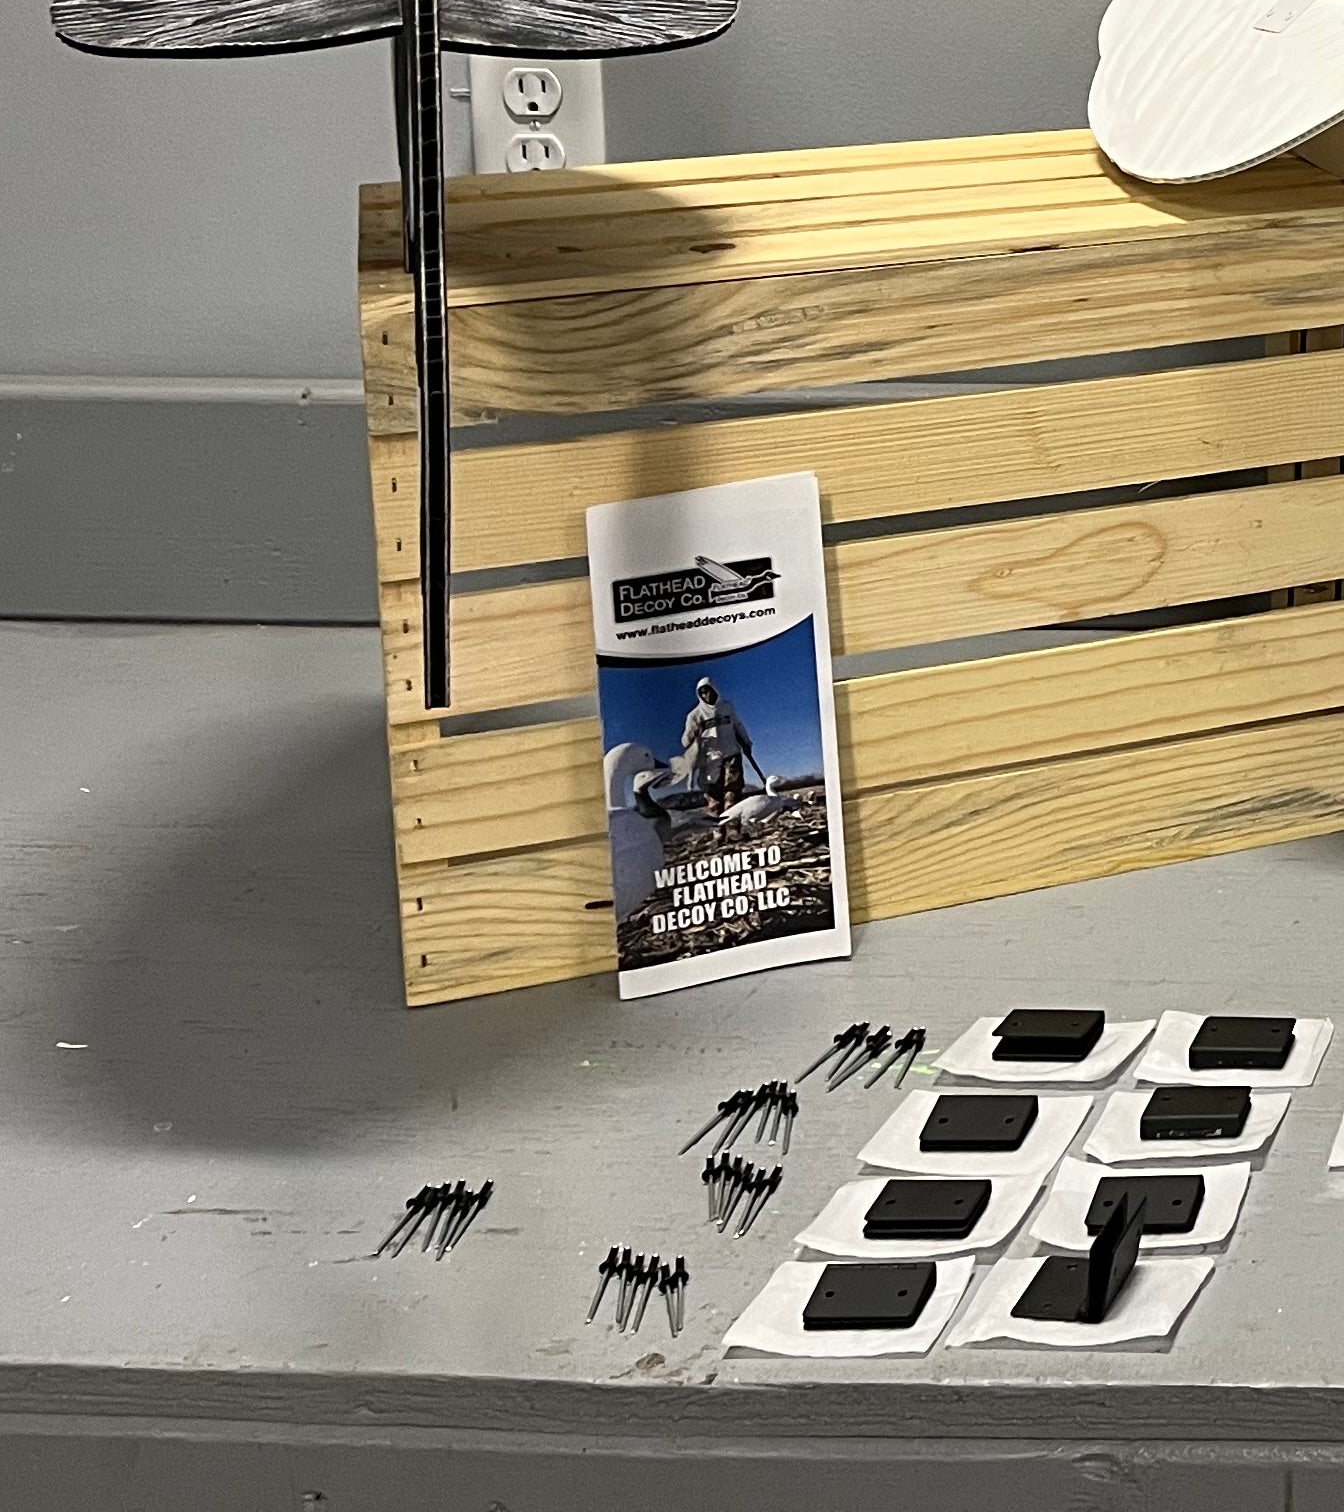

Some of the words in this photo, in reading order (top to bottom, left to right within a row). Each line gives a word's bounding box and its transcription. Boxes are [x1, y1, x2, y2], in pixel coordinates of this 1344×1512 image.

[619, 575, 706, 601] FLATHEAD
[616, 607, 776, 640] www.flatheaddecoys.com
[620, 598, 676, 617] DECOY
[654, 851, 752, 889] WELCOME
[754, 845, 781, 867] TO
[673, 870, 767, 908] FLATHEAD
[652, 901, 717, 934] DECOY
[720, 895, 754, 919] CO.
[757, 887, 790, 911] LLC
